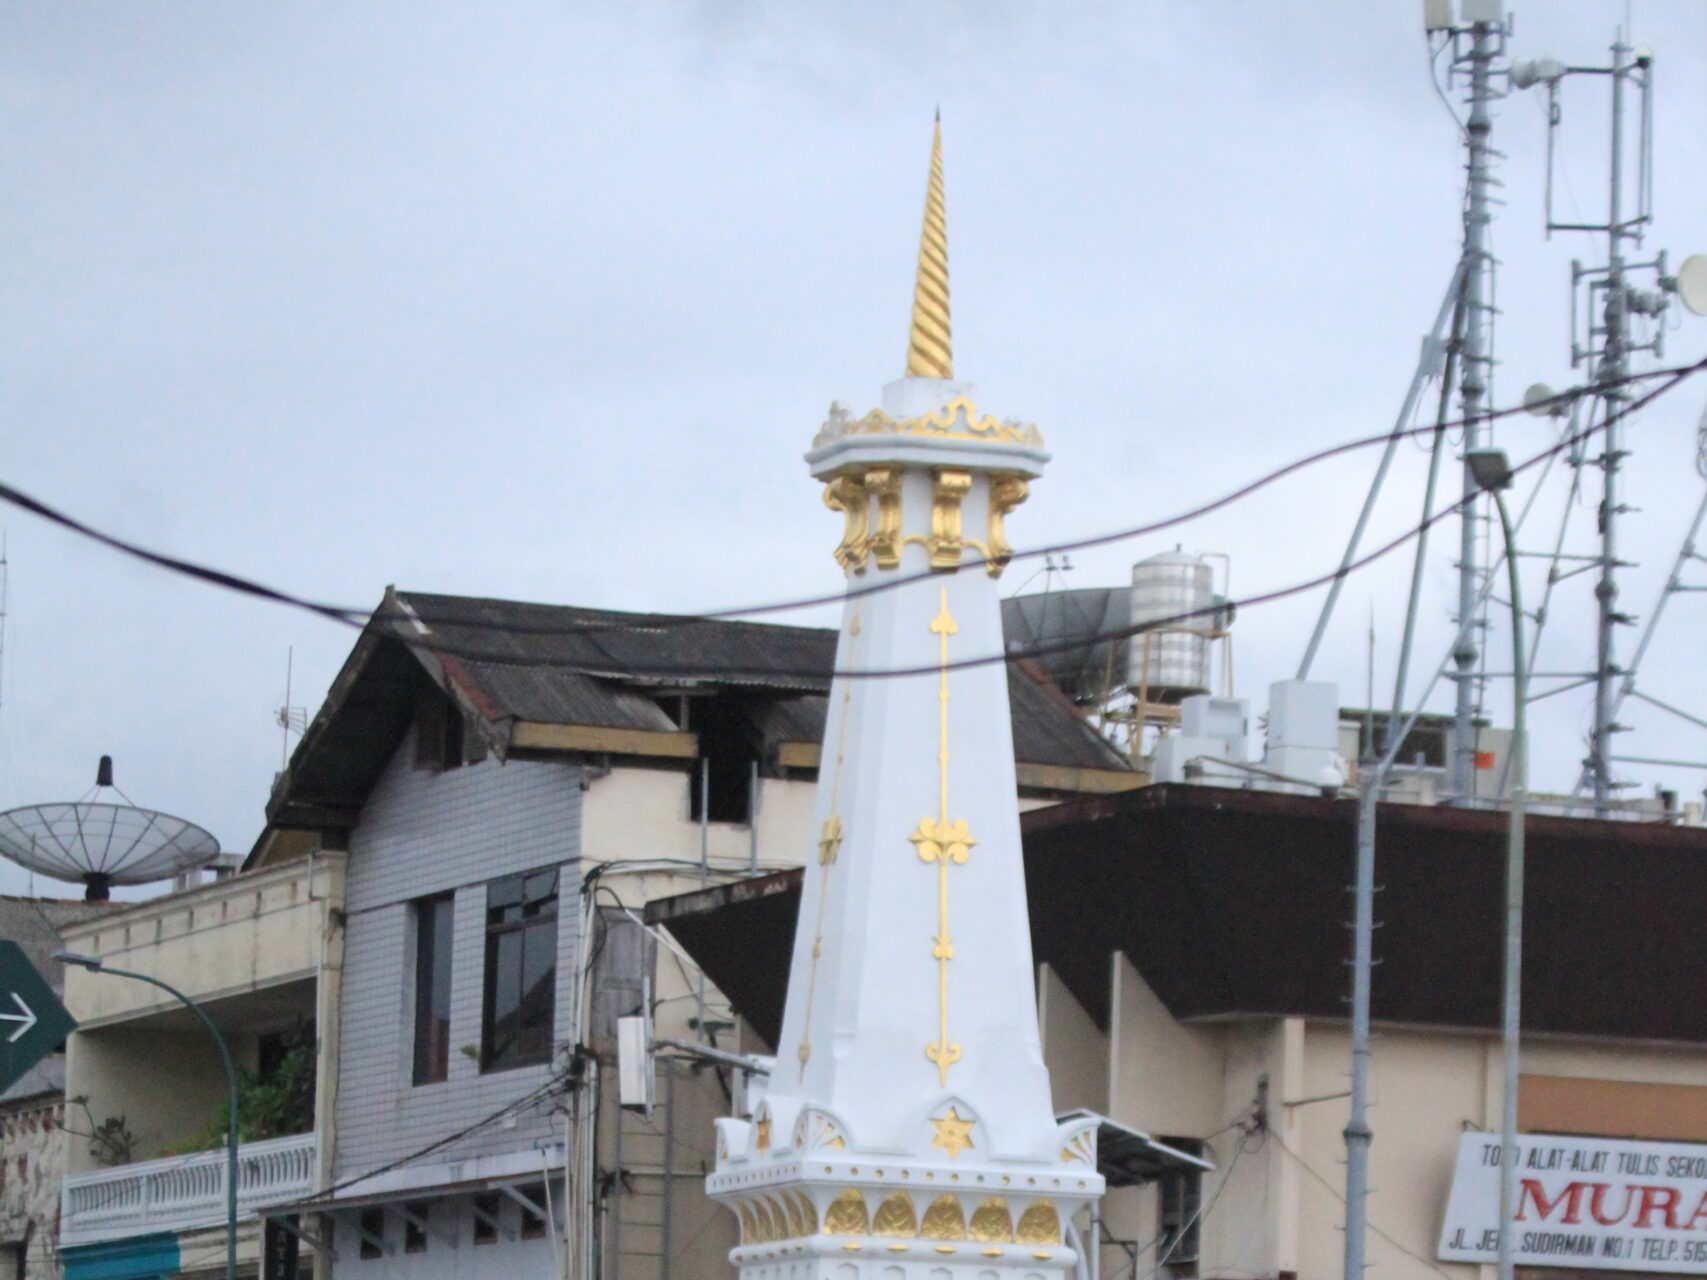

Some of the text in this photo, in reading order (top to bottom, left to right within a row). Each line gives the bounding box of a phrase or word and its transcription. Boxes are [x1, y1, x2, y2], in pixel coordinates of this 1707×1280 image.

[1481, 1144, 1520, 1167] TO
[1527, 1147, 1610, 1173] ALAT-ALAT
[1618, 1152, 1660, 1177] TULIS
[1522, 1232, 1597, 1256] SUDIRMAN
